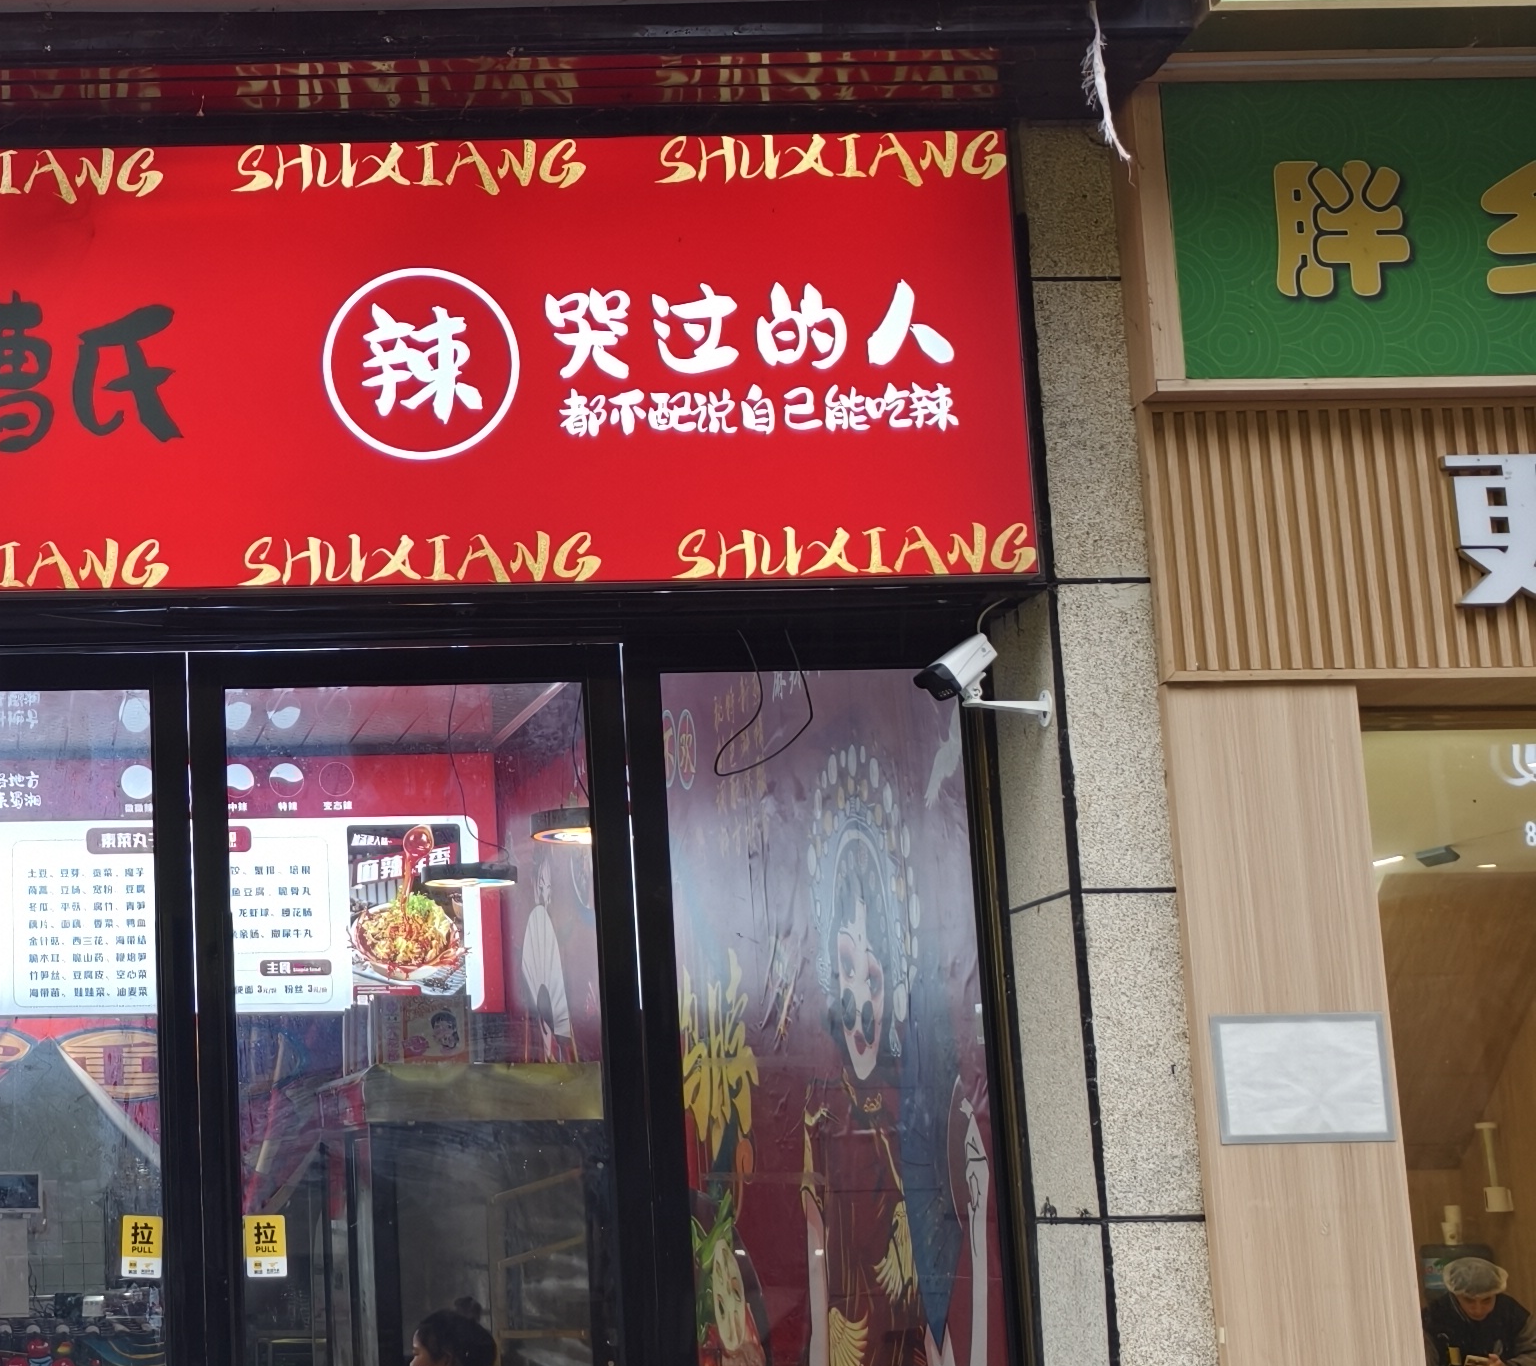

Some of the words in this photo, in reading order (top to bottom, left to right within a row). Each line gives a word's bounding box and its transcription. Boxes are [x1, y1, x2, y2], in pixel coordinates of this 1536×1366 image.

[230, 138, 587, 196] SHUXIANG
[655, 129, 1008, 187] SHUXIANG
[361, 301, 484, 426] 辣
[544, 278, 955, 381] 哭过的人
[558, 382, 960, 438] 都不配说自己能吃辣
[237, 530, 602, 587] SHUXIANG
[672, 522, 1038, 579] SHUXIANG
[131, 1222, 154, 1245] 拉
[131, 1245, 154, 1254] PULL
[254, 1222, 278, 1245] 拉
[255, 1245, 278, 1253] PULL
